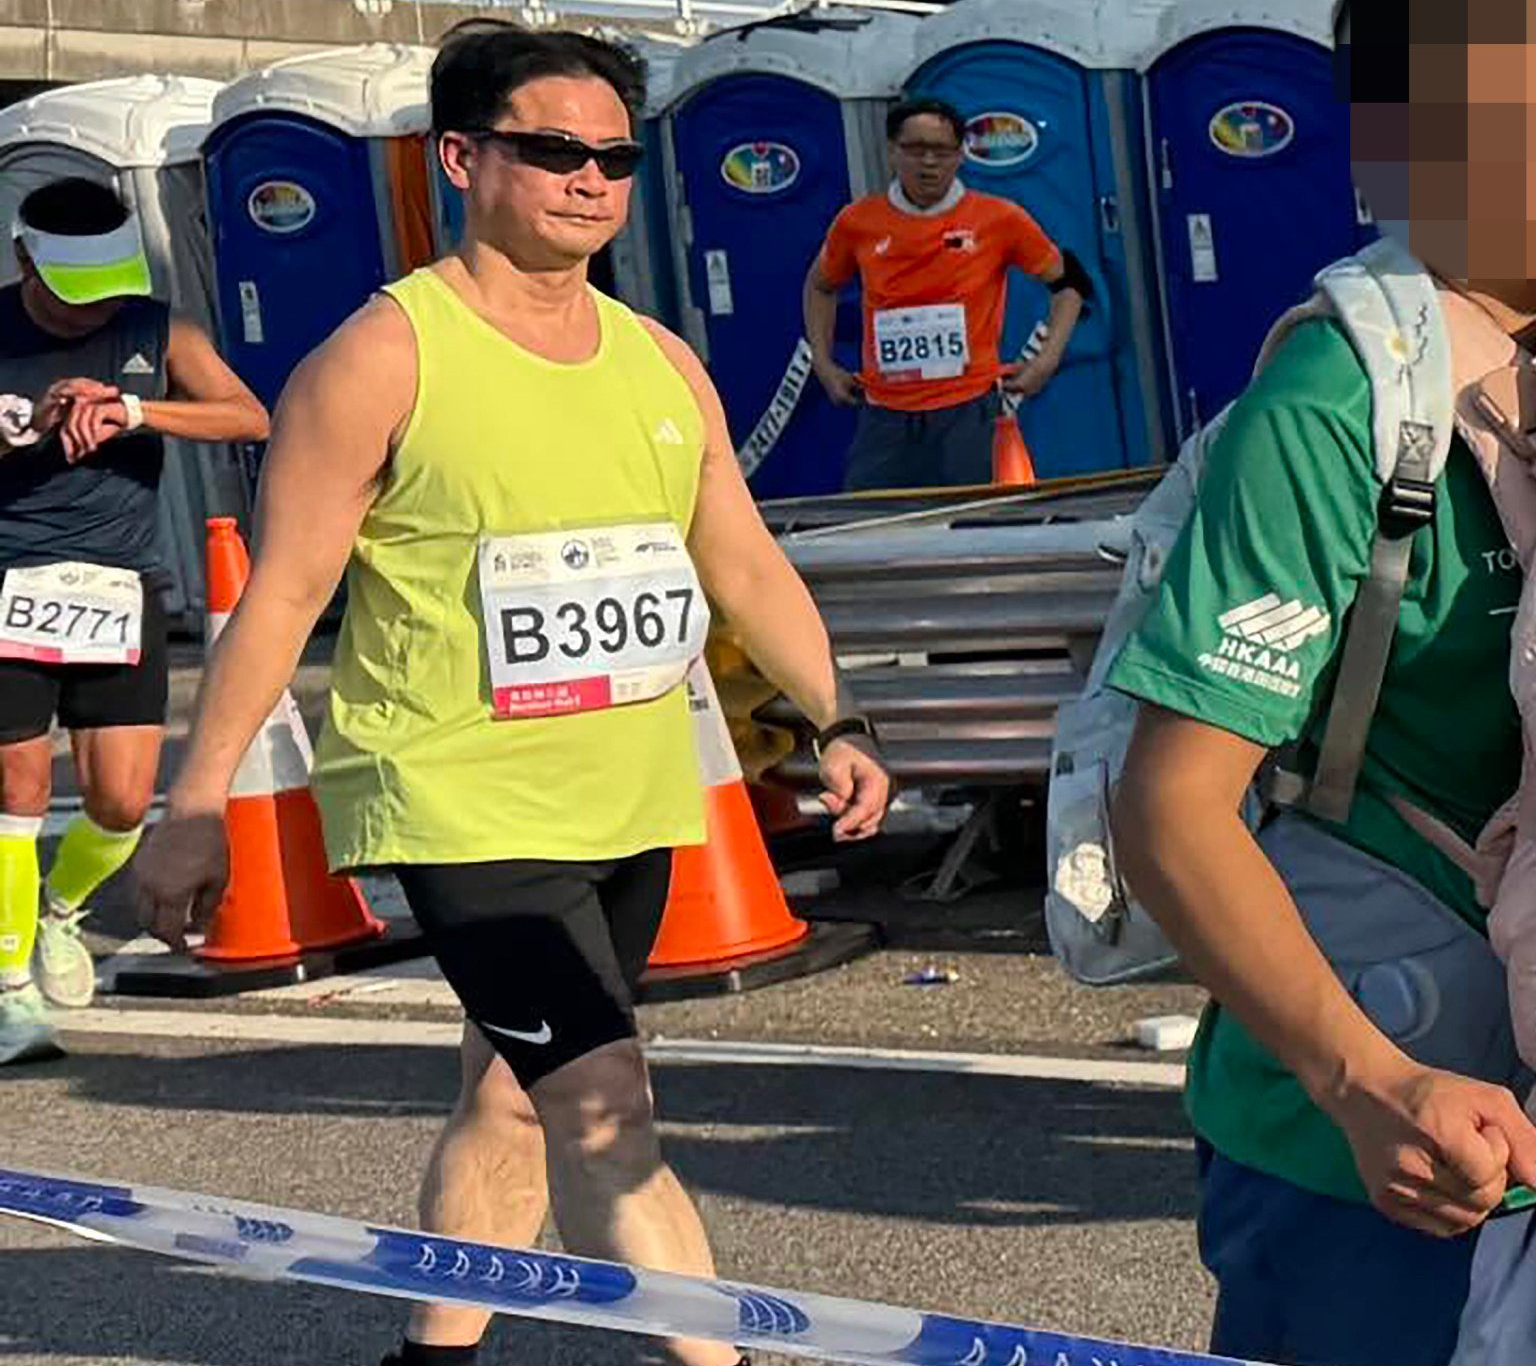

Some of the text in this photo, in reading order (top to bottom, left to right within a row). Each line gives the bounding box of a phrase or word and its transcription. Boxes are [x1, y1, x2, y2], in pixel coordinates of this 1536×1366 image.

[881, 332, 964, 363] B2815
[6, 595, 130, 643] B2771
[500, 588, 694, 665] B3967
[1218, 636, 1300, 680] HKAAA
